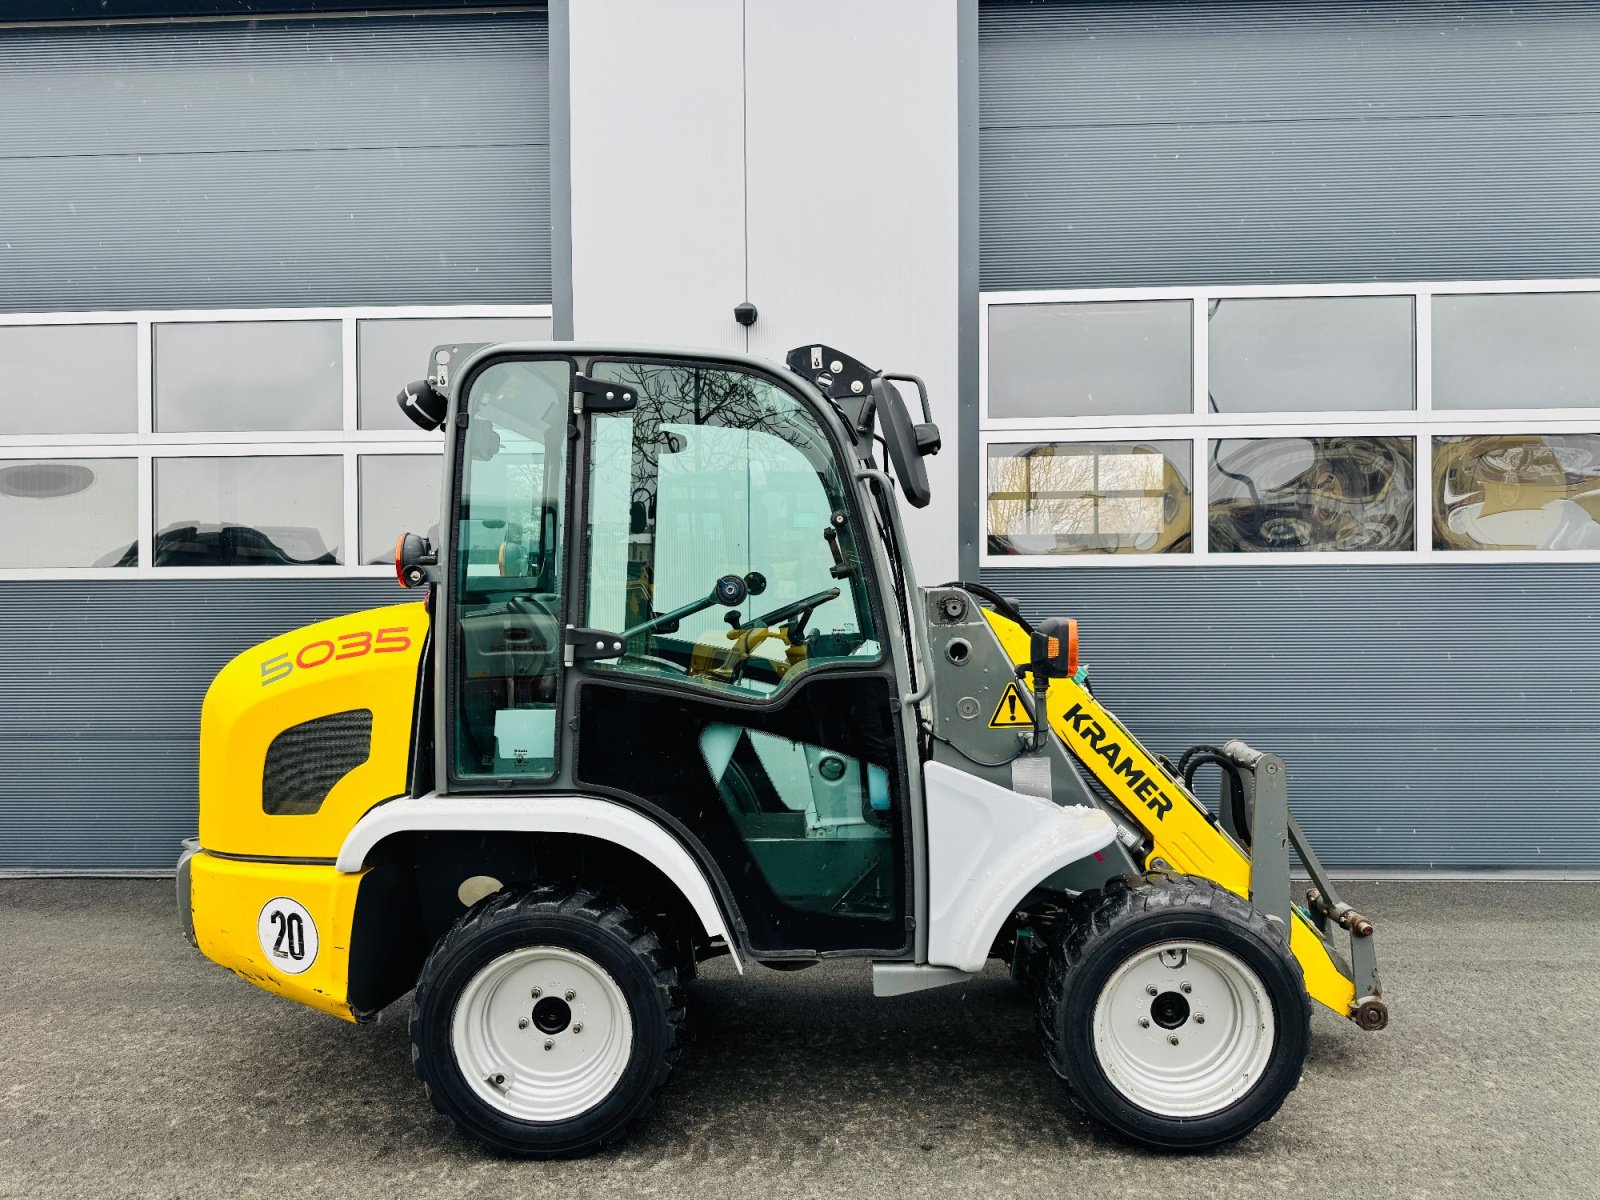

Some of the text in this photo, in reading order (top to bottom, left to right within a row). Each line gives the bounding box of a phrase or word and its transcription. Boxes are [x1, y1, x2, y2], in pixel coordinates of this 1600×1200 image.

[260, 626, 411, 687] 5035
[1062, 702, 1173, 822] KRAMER
[270, 909, 305, 961] 20
